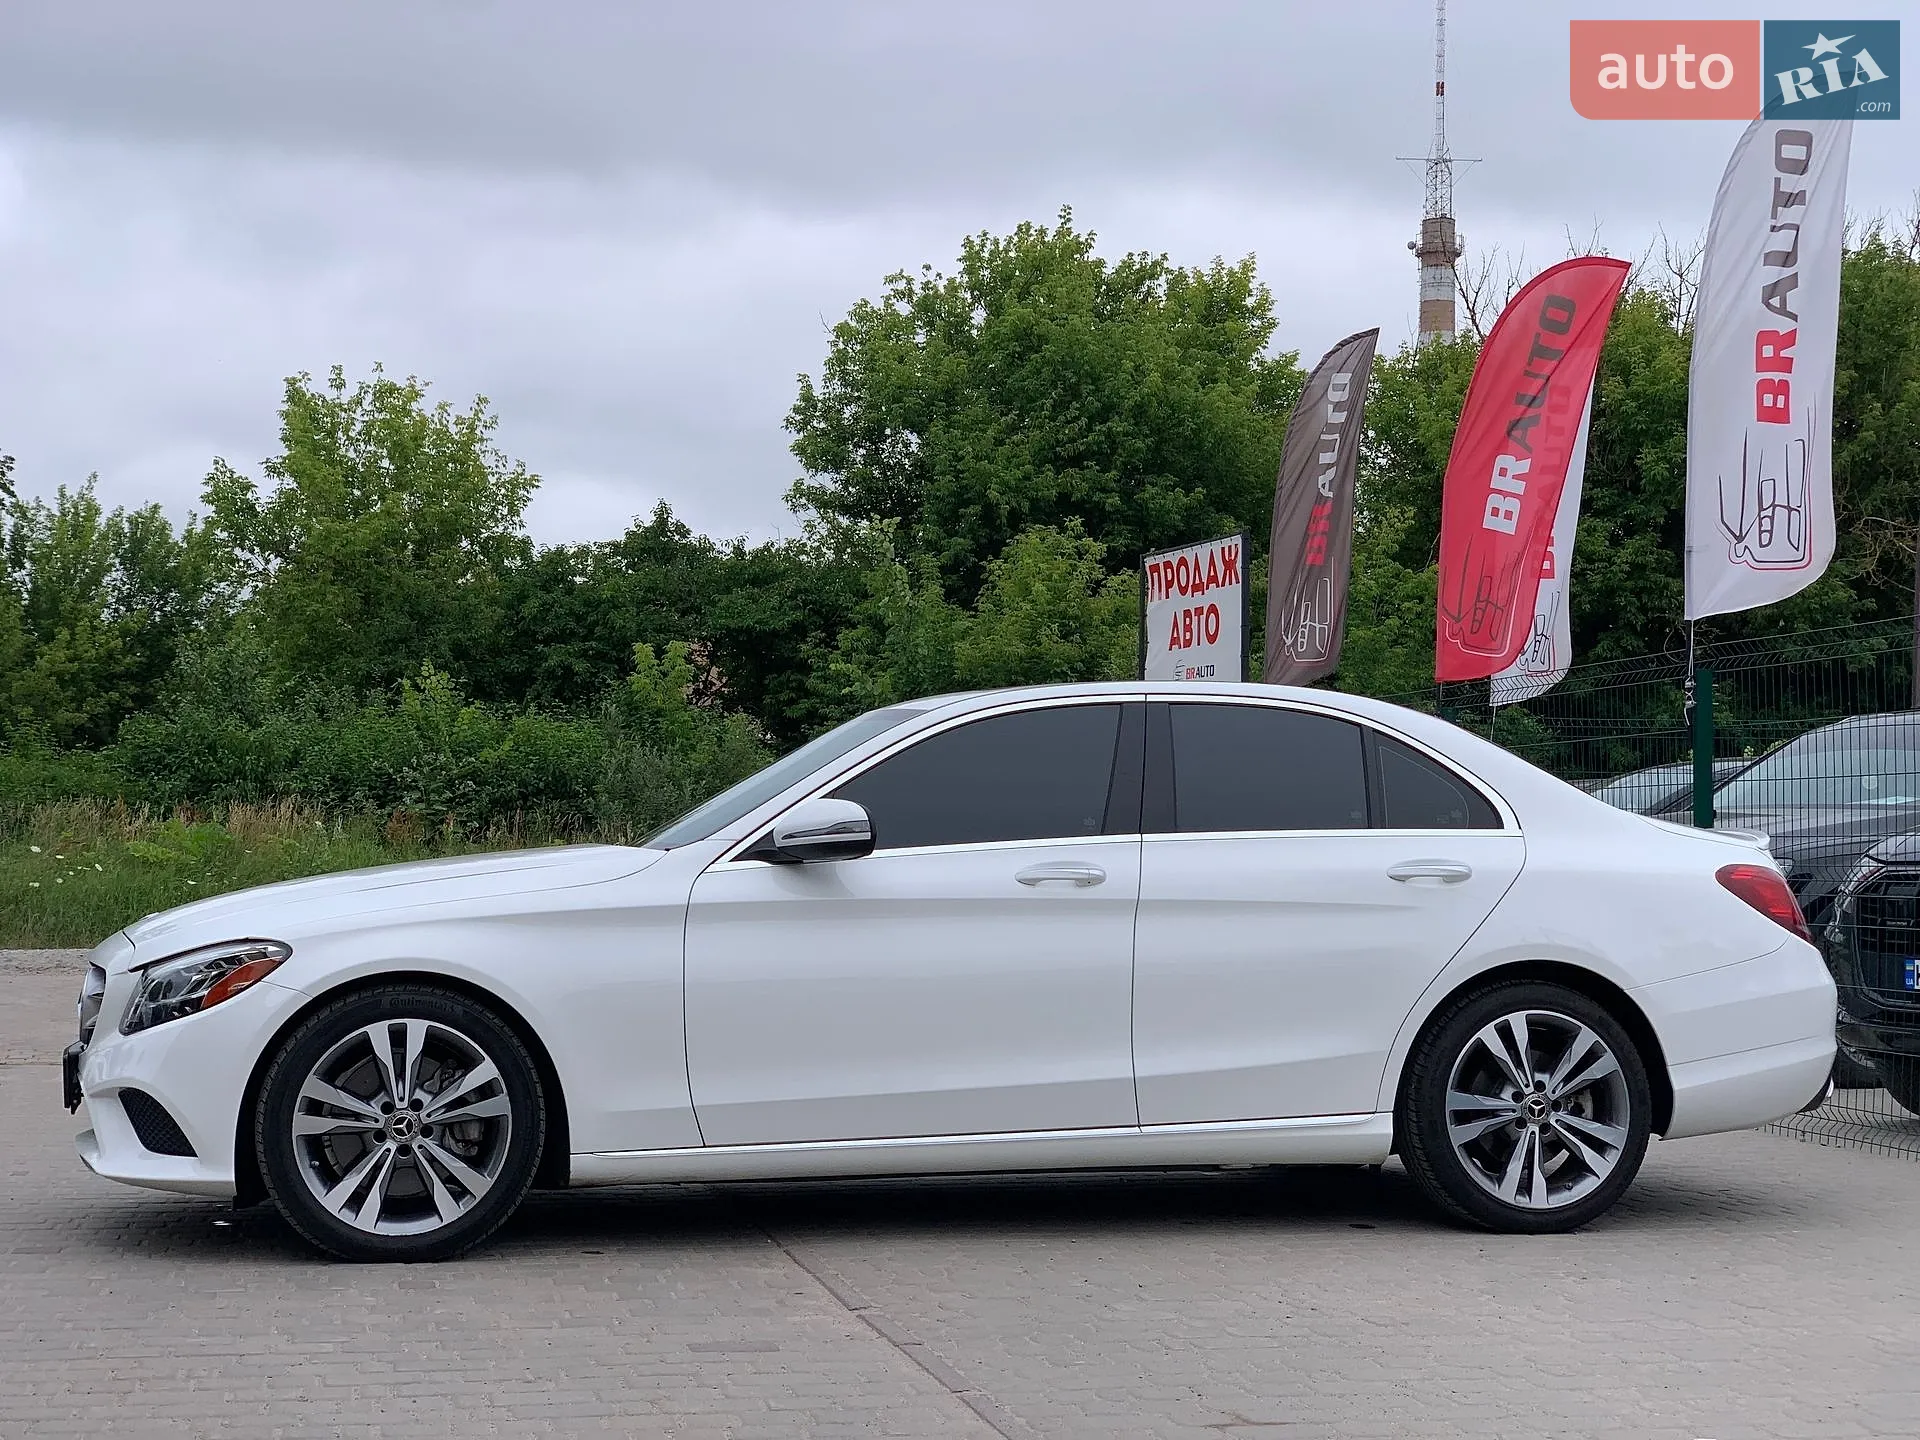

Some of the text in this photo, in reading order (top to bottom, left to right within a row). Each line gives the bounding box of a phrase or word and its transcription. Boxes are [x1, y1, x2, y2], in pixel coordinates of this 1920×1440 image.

[1755, 129, 1813, 425] BRAUTO
[1305, 372, 1353, 566] BRAUTO
[1482, 294, 1577, 536] BRAUTO
[1149, 544, 1240, 602] ПРОДАЖ
[1168, 603, 1220, 651] АВТО
[1185, 664, 1215, 680] BRAUTO
